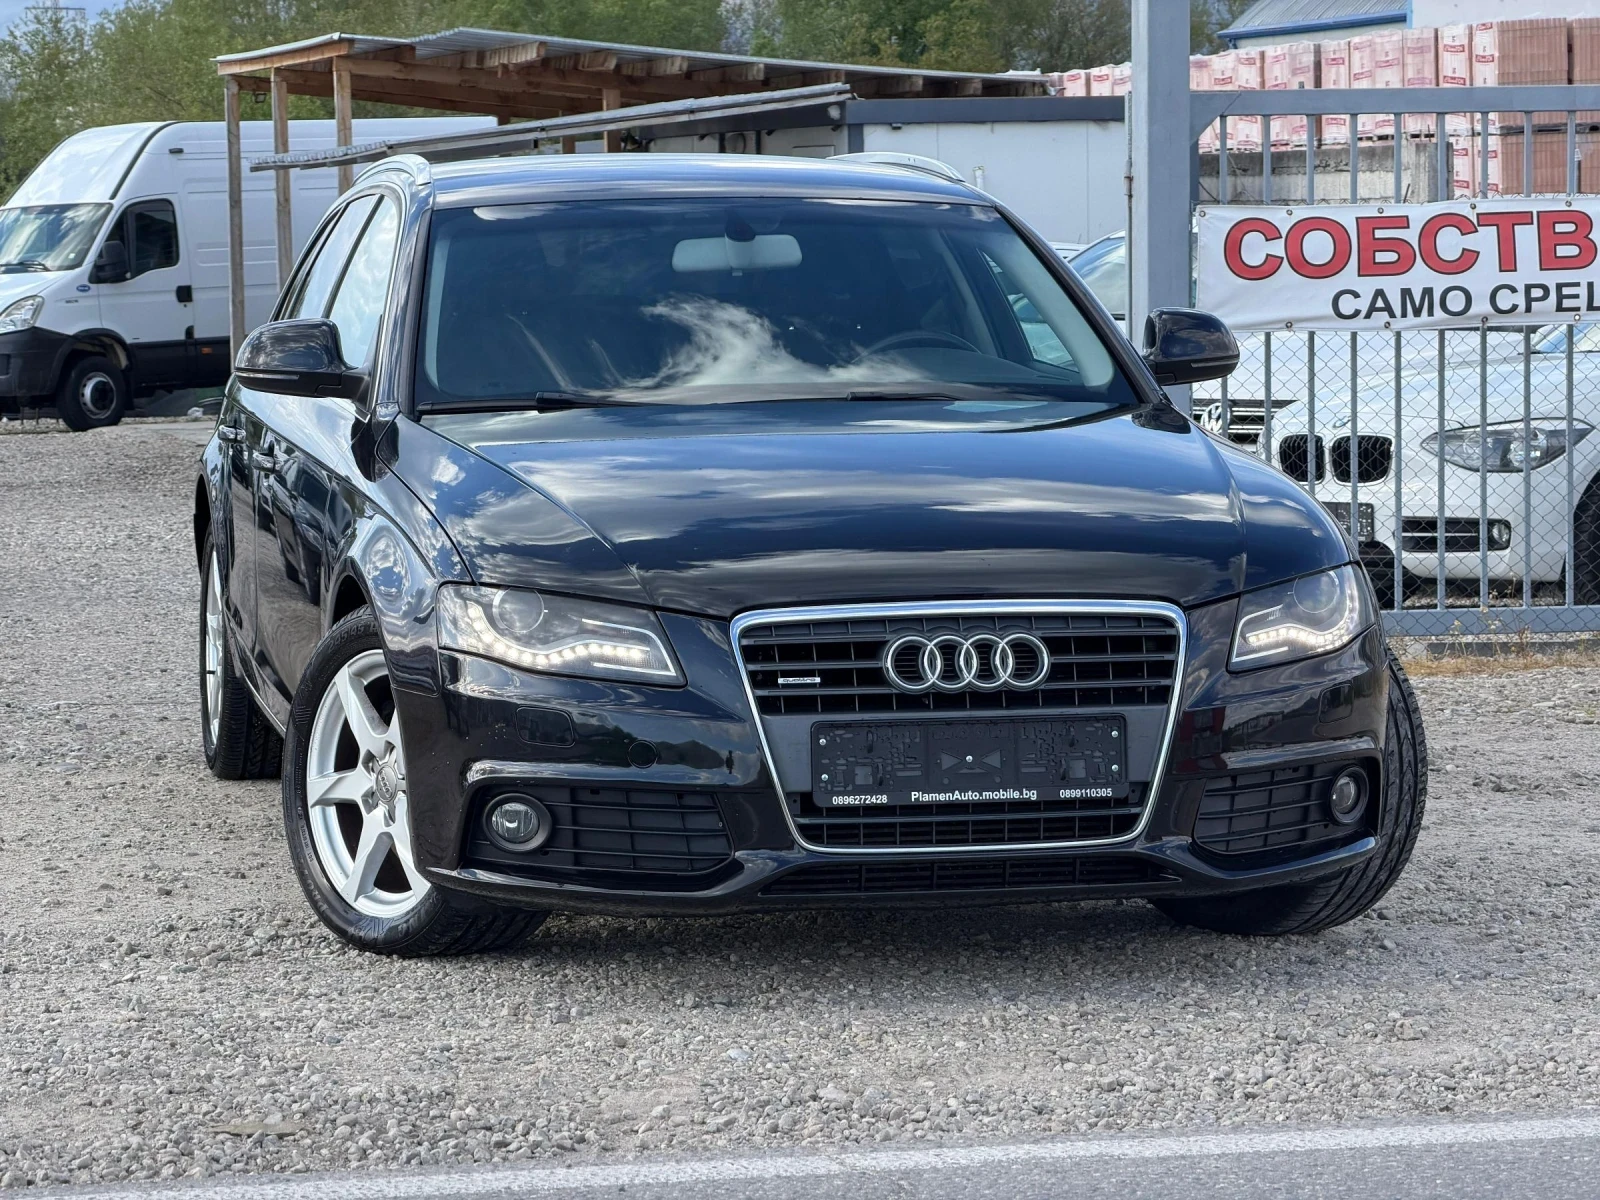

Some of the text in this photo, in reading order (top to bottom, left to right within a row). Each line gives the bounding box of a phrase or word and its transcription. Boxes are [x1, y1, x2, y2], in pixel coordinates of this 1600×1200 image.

[1224, 210, 1598, 281] СОБСТВ
[1331, 287, 1473, 320] САМО
[832, 787, 1113, 806] 0896272428 PlamenAuto.mobile.bg 0899110305
